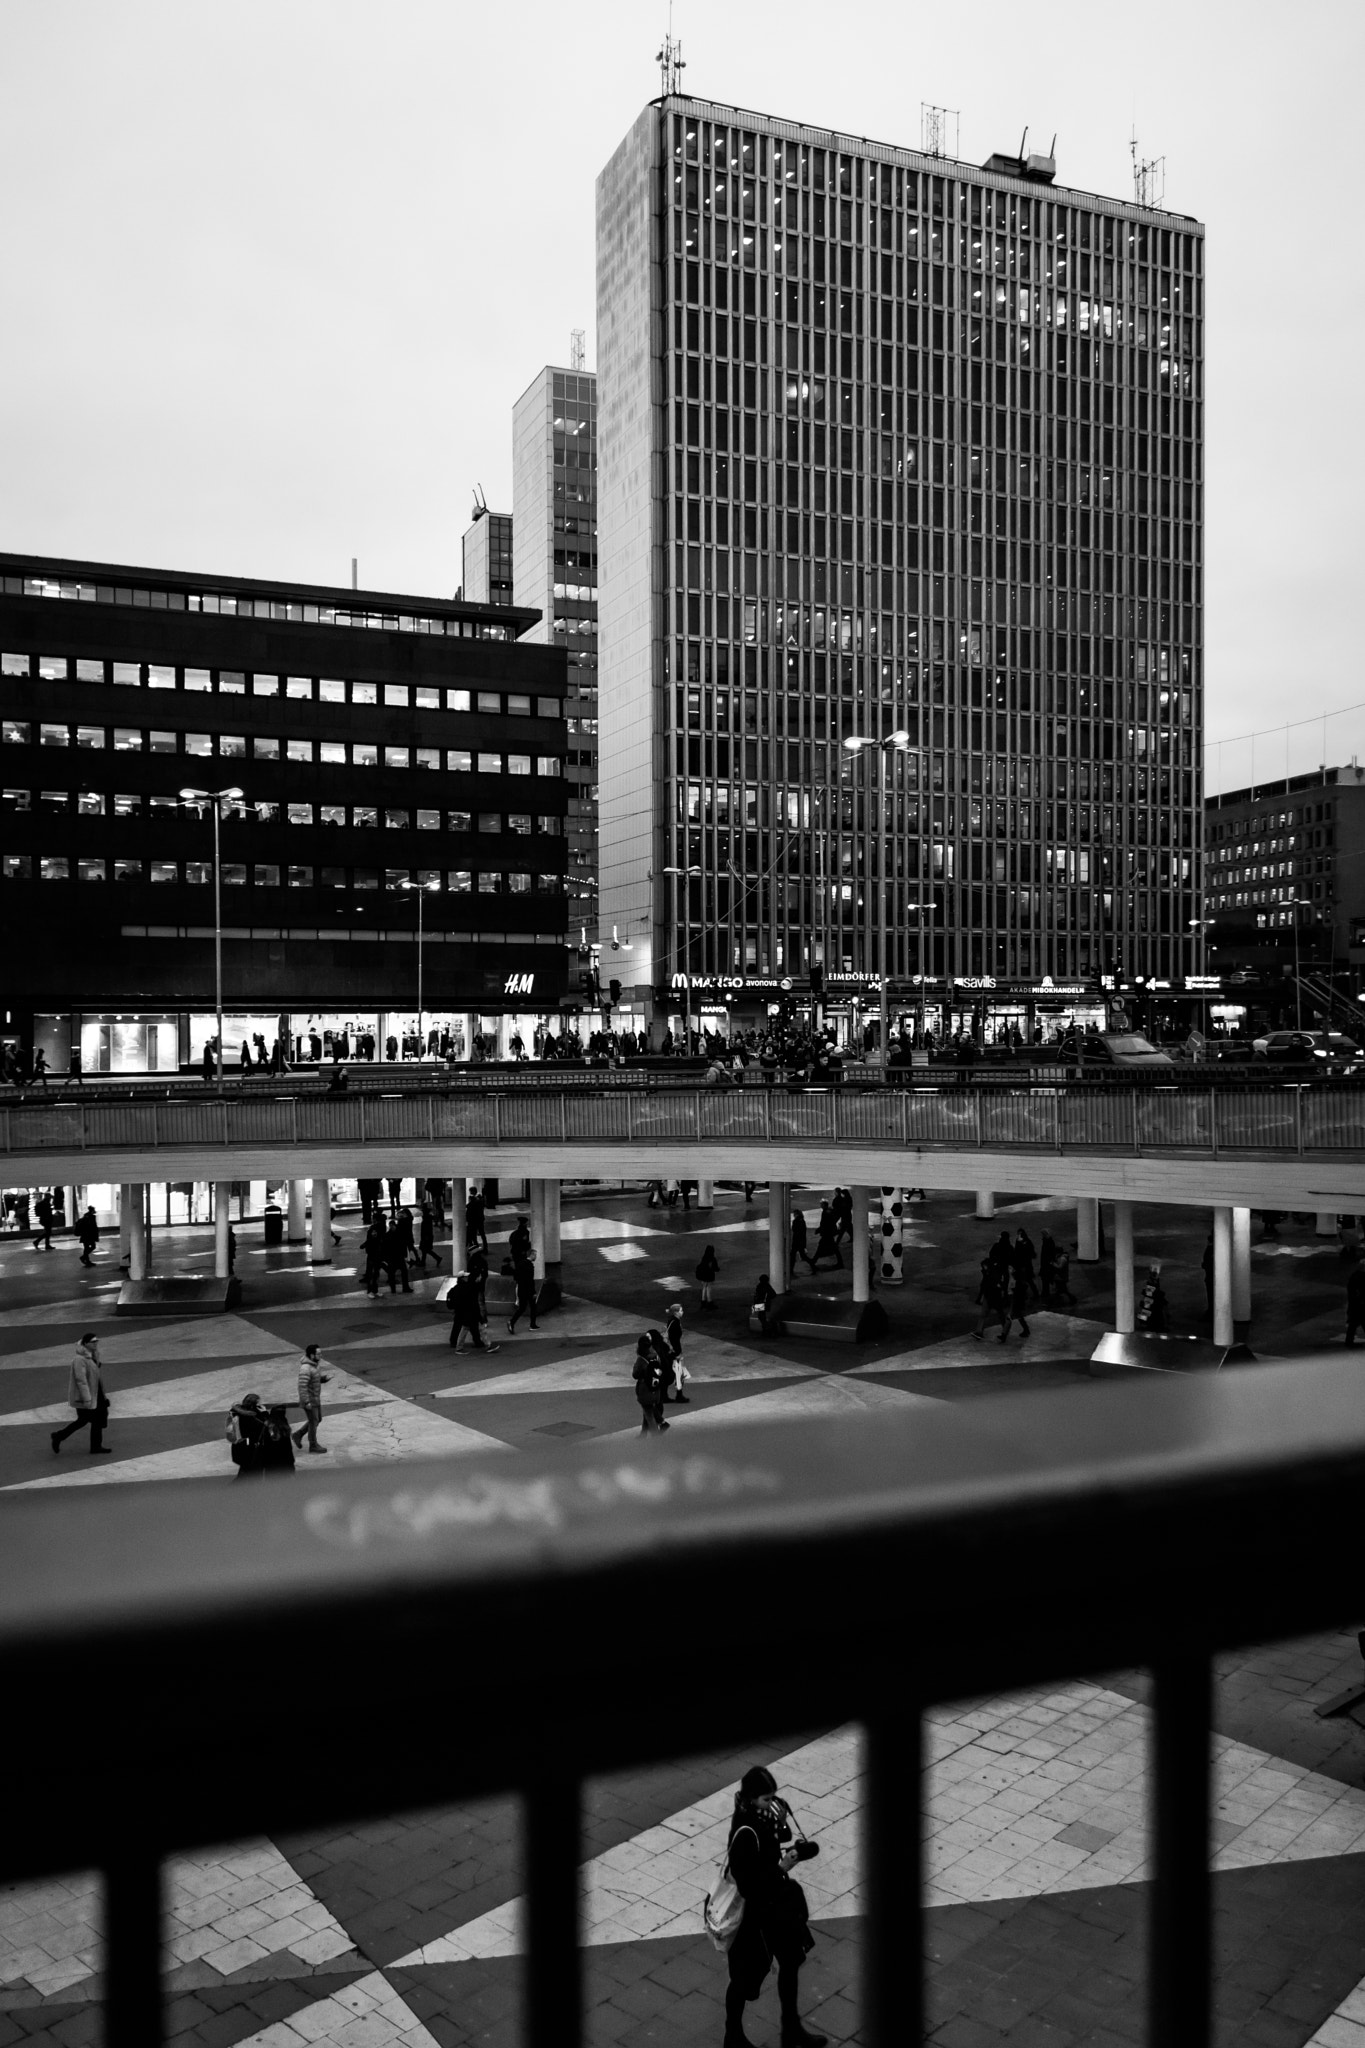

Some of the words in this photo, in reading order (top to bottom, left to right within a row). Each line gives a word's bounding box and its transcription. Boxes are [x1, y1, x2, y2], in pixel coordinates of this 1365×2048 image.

[825, 971, 881, 981] EIMDÖRFER
[963, 975, 997, 988] savills
[504, 973, 535, 994] H&M
[745, 979, 778, 987] avonova
